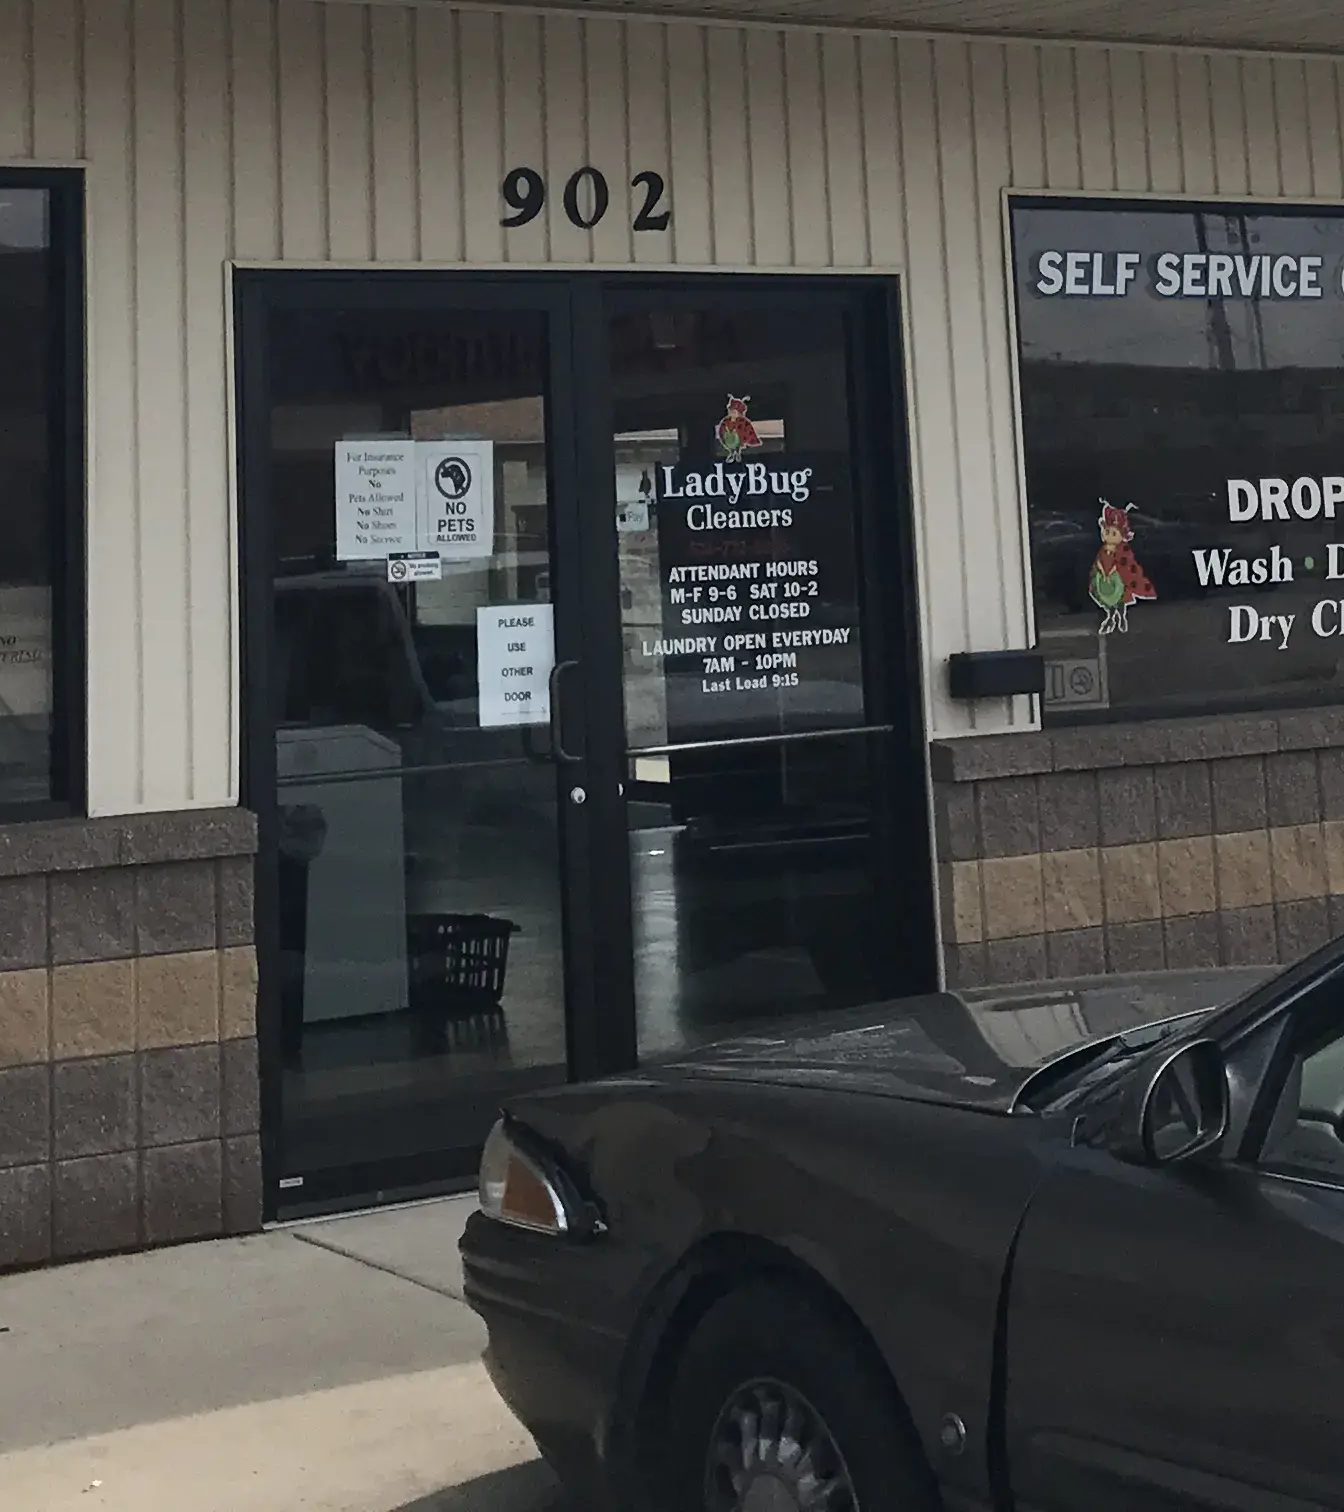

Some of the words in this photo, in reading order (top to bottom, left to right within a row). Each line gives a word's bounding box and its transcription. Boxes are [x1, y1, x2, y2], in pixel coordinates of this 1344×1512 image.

[499, 166, 671, 232] 902
[1036, 251, 1140, 296] SELF
[1155, 253, 1322, 298] SERVICE
[368, 479, 382, 489] No
[662, 463, 813, 505] LadyBug
[349, 493, 366, 503] Pets
[368, 492, 404, 502] Allowed
[357, 506, 371, 516] No
[445, 501, 467, 515] NO
[356, 520, 370, 530] No
[437, 518, 475, 532] PETS
[687, 504, 793, 531] Cleaners
[355, 535, 368, 544] No
[436, 533, 477, 542] ALLOWED
[668, 563, 761, 584] ATTENDANT
[766, 560, 819, 578] HOURS
[1192, 544, 1294, 587] Wash
[670, 587, 703, 605] M-F
[708, 585, 737, 602] 9-6
[749, 583, 778, 600] SAT
[783, 580, 819, 597] 10-2
[498, 616, 535, 628] PLEASE
[681, 605, 743, 625] SUNDAY
[748, 602, 810, 621] CLOSED
[1227, 604, 1296, 651] Dry
[507, 642, 526, 652] USE
[642, 636, 718, 657] LAUNDRY
[723, 633, 767, 651] OPEN
[772, 627, 851, 649] EVERYDAY
[501, 666, 534, 677] OTHER
[702, 656, 735, 674] 7AM
[755, 652, 797, 671] 10PM
[702, 677, 731, 693] Last
[735, 675, 768, 690] Load
[772, 672, 799, 687] 9:15
[504, 690, 532, 702] DOOR
